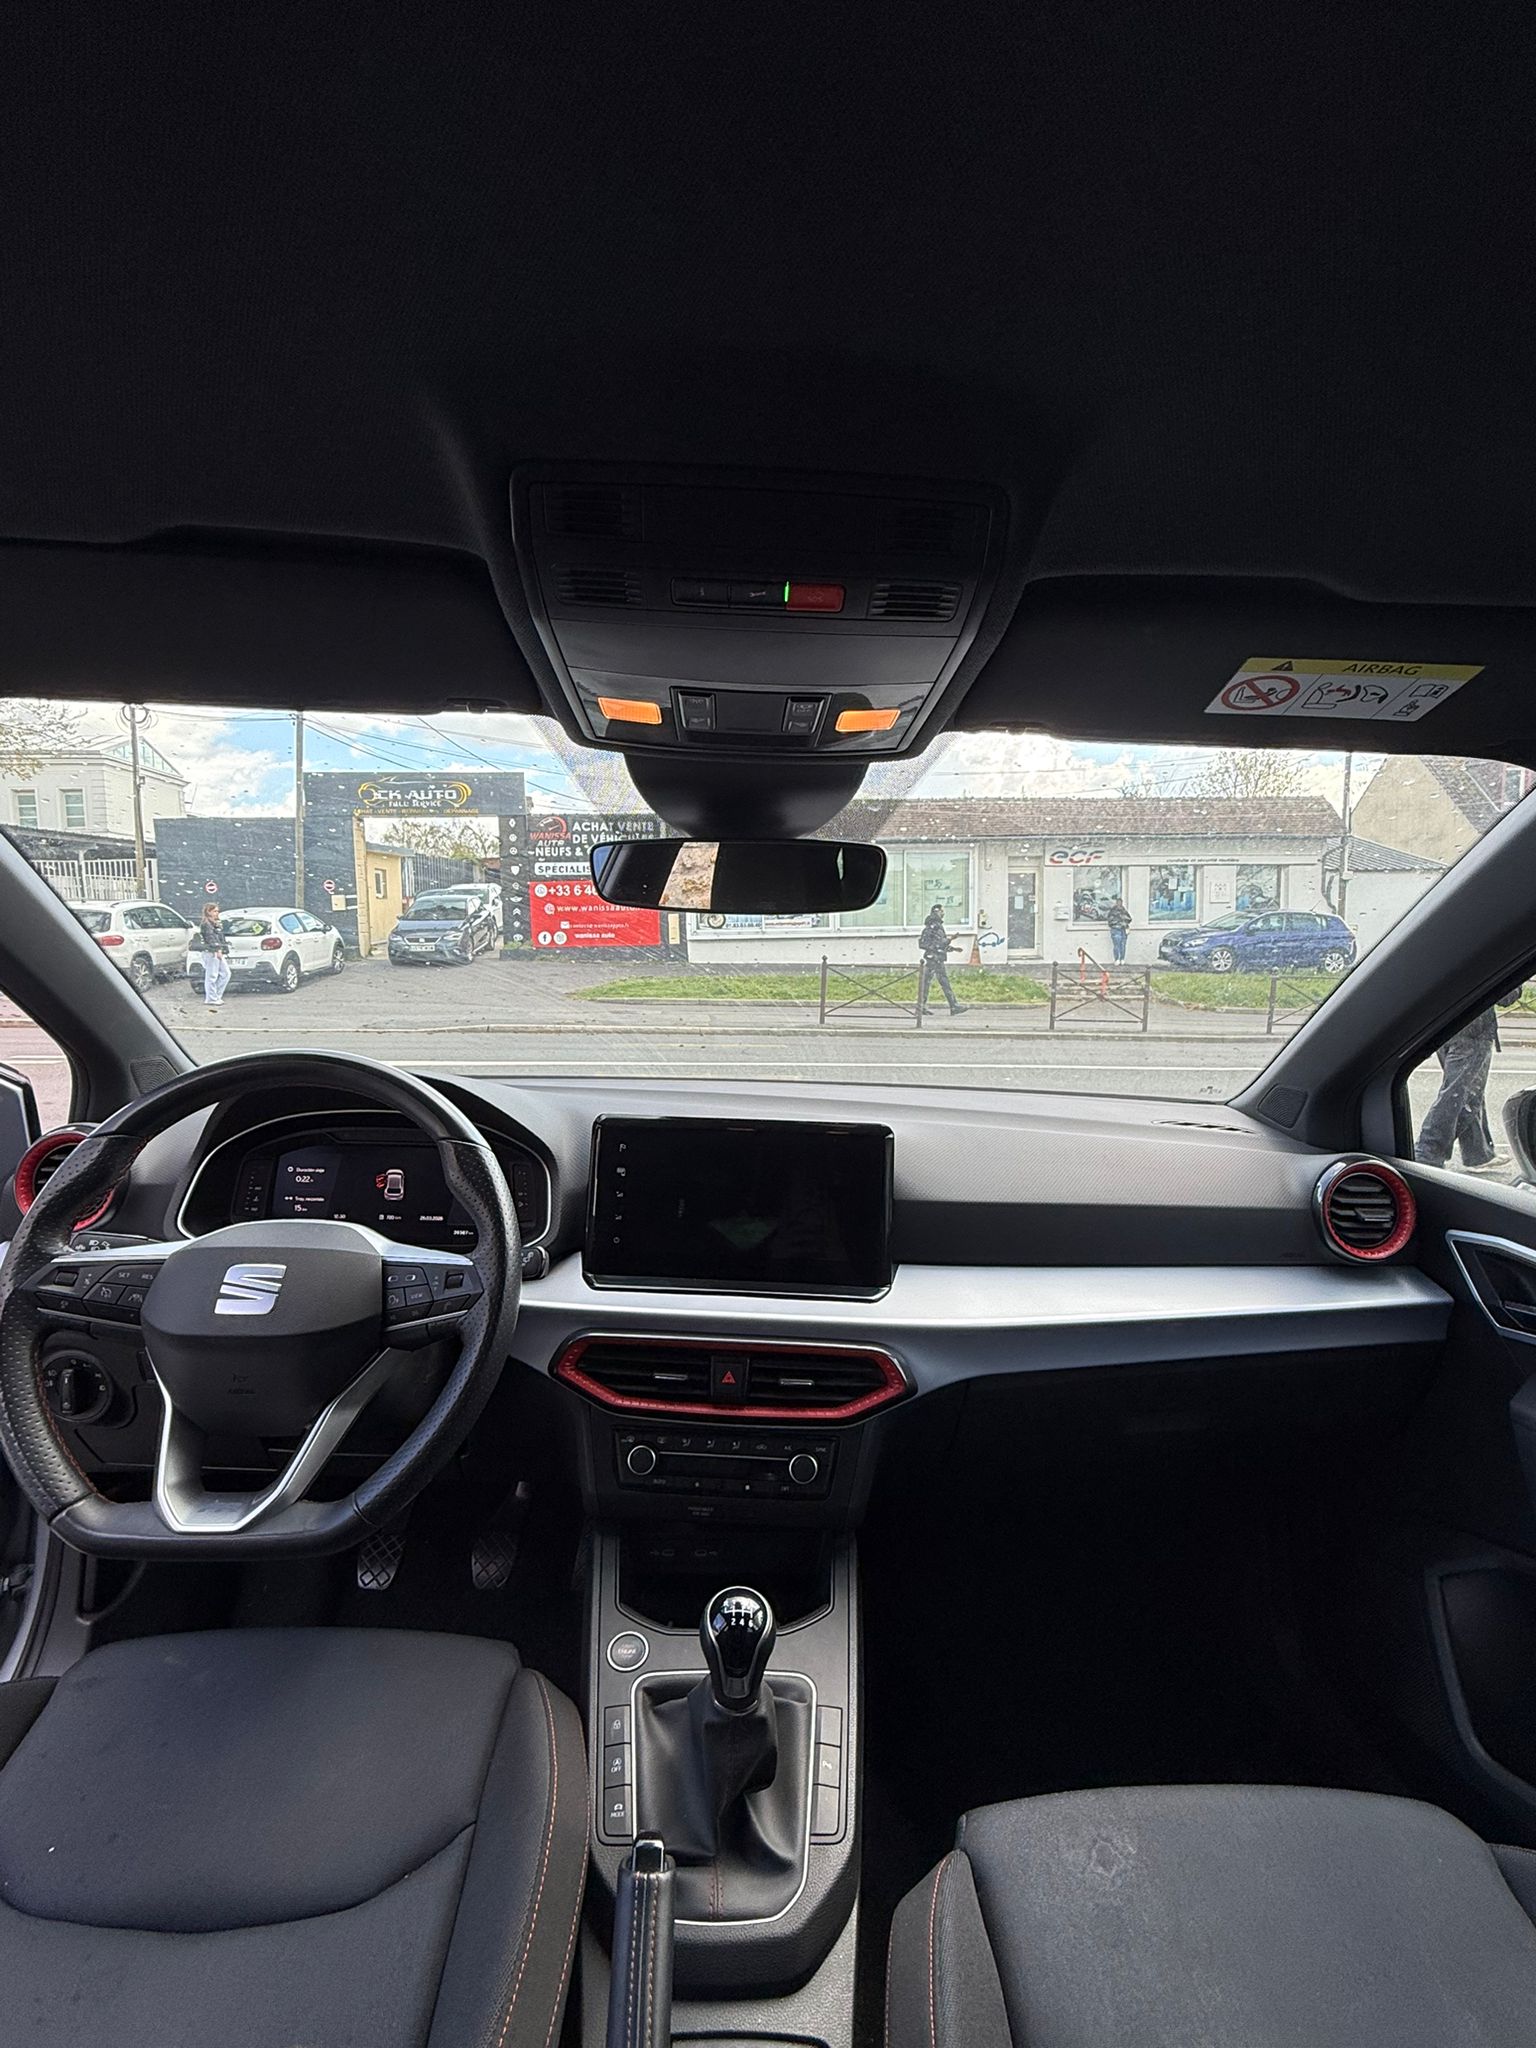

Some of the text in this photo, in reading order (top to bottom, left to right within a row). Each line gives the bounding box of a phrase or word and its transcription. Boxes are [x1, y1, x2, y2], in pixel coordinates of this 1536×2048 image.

[1342, 663, 1423, 675] AIRBAG
[406, 789, 457, 800] AUTO
[573, 821, 654, 832] ACHAT VENTE
[530, 832, 572, 840] WANISSA
[572, 834, 588, 844] DE
[535, 846, 572, 857] NEUFS
[575, 846, 584, 856] &
[549, 884, 570, 896] +33
[573, 884, 582, 896] 6
[731, 1617, 737, 1626] 2
[739, 1618, 745, 1626] 4
[748, 1619, 754, 1628] 6
